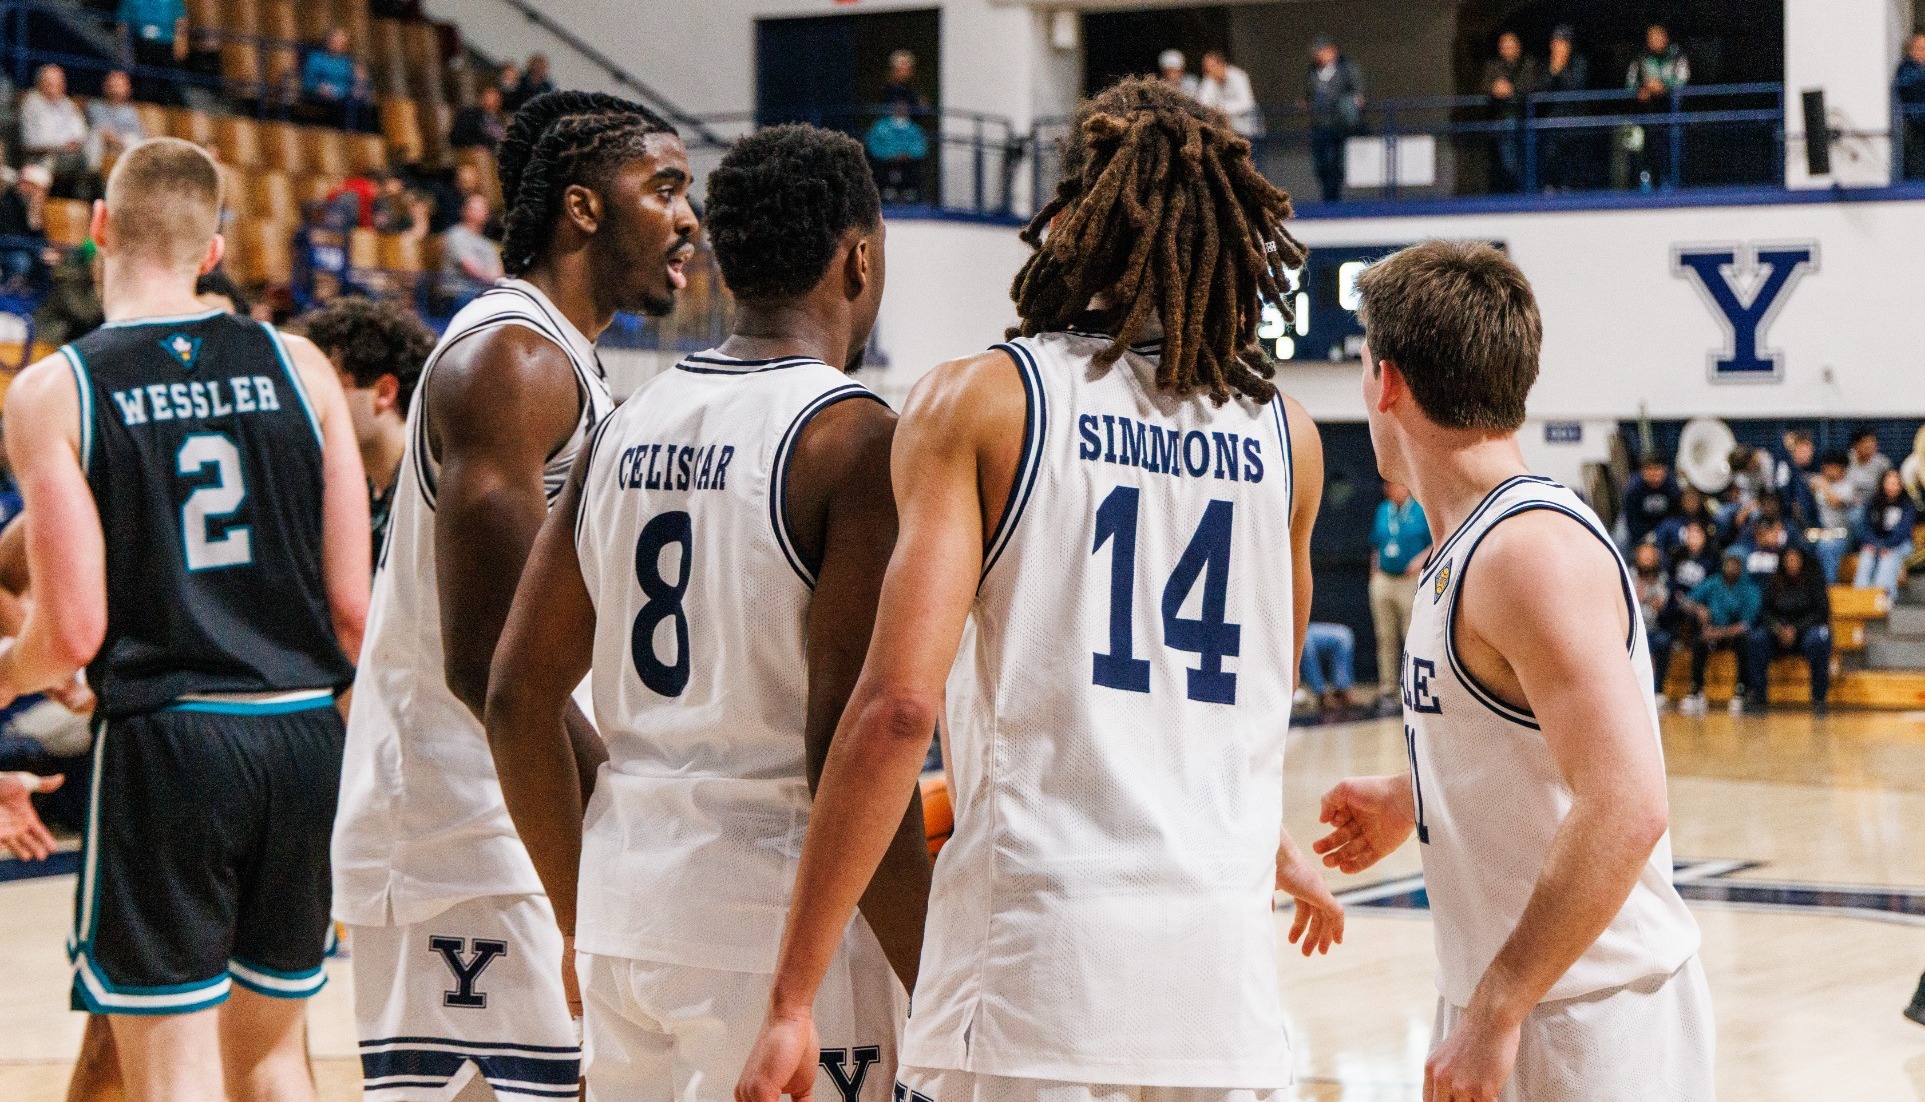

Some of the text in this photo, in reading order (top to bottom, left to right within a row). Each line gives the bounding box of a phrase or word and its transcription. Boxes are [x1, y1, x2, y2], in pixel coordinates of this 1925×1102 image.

[1671, 240, 1820, 383] Y
[113, 375, 280, 426] WESSLER
[1079, 413, 1264, 483] SIMMONS
[176, 431, 253, 573] 2
[619, 444, 735, 491] CELISCAR
[632, 510, 693, 697] 8
[1092, 485, 1241, 705] 14
[428, 935, 507, 1009] Y
